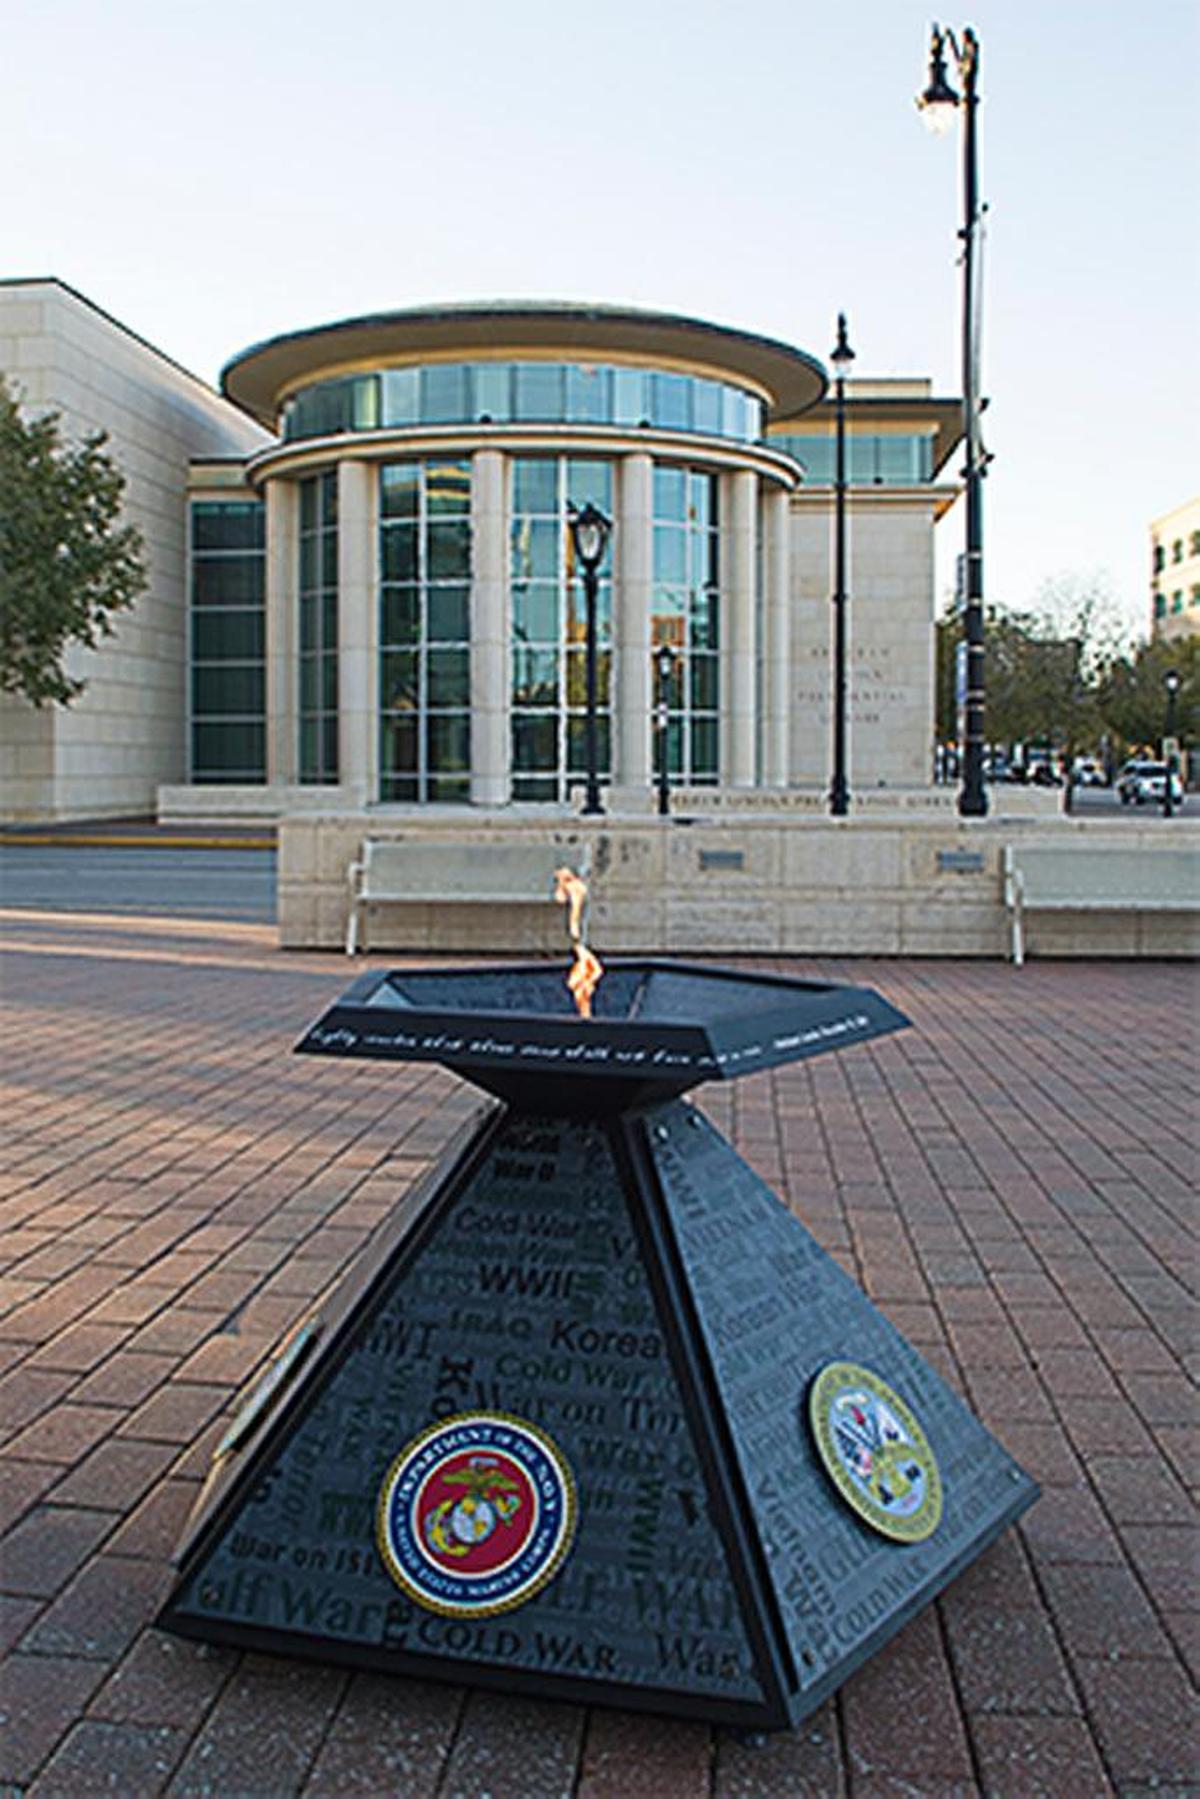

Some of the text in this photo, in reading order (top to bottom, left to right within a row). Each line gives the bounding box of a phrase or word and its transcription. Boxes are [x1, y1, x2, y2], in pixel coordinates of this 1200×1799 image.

[453, 1206, 580, 1239] Cold War
[477, 1263, 575, 1300] WWII
[550, 1319, 662, 1360] Korea
[494, 1351, 572, 1385] Cold
[292, 1546, 328, 1570] on
[416, 1611, 622, 1675] COLD WAR
